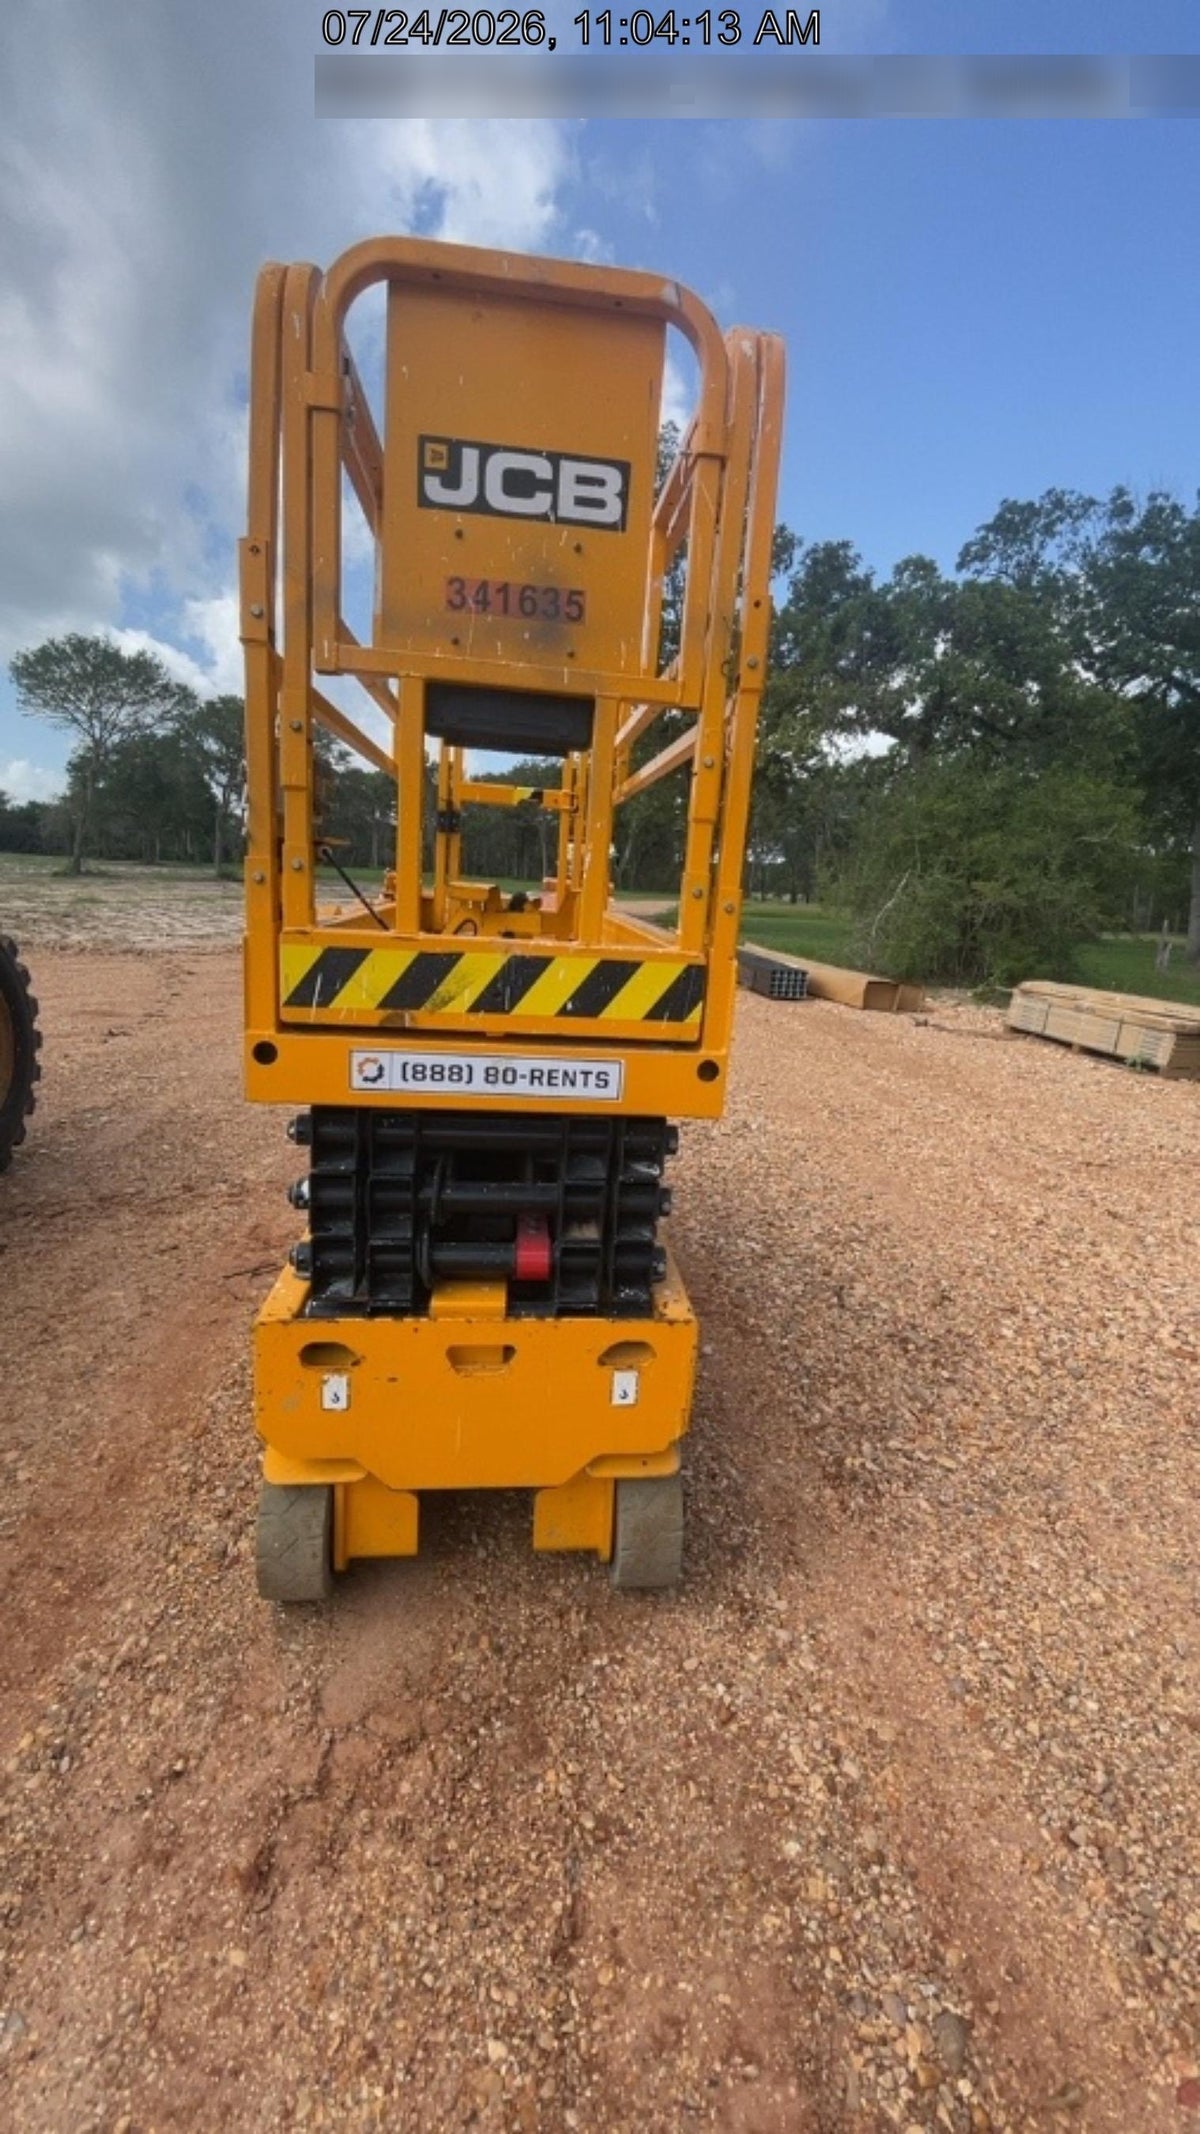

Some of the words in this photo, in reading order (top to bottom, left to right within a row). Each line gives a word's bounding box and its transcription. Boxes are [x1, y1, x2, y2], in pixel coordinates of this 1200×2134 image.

[424, 447, 623, 523] JCB
[447, 577, 585, 622] 341635
[401, 1061, 473, 1084] (888)
[484, 1066, 610, 1089] 80-RENTS
